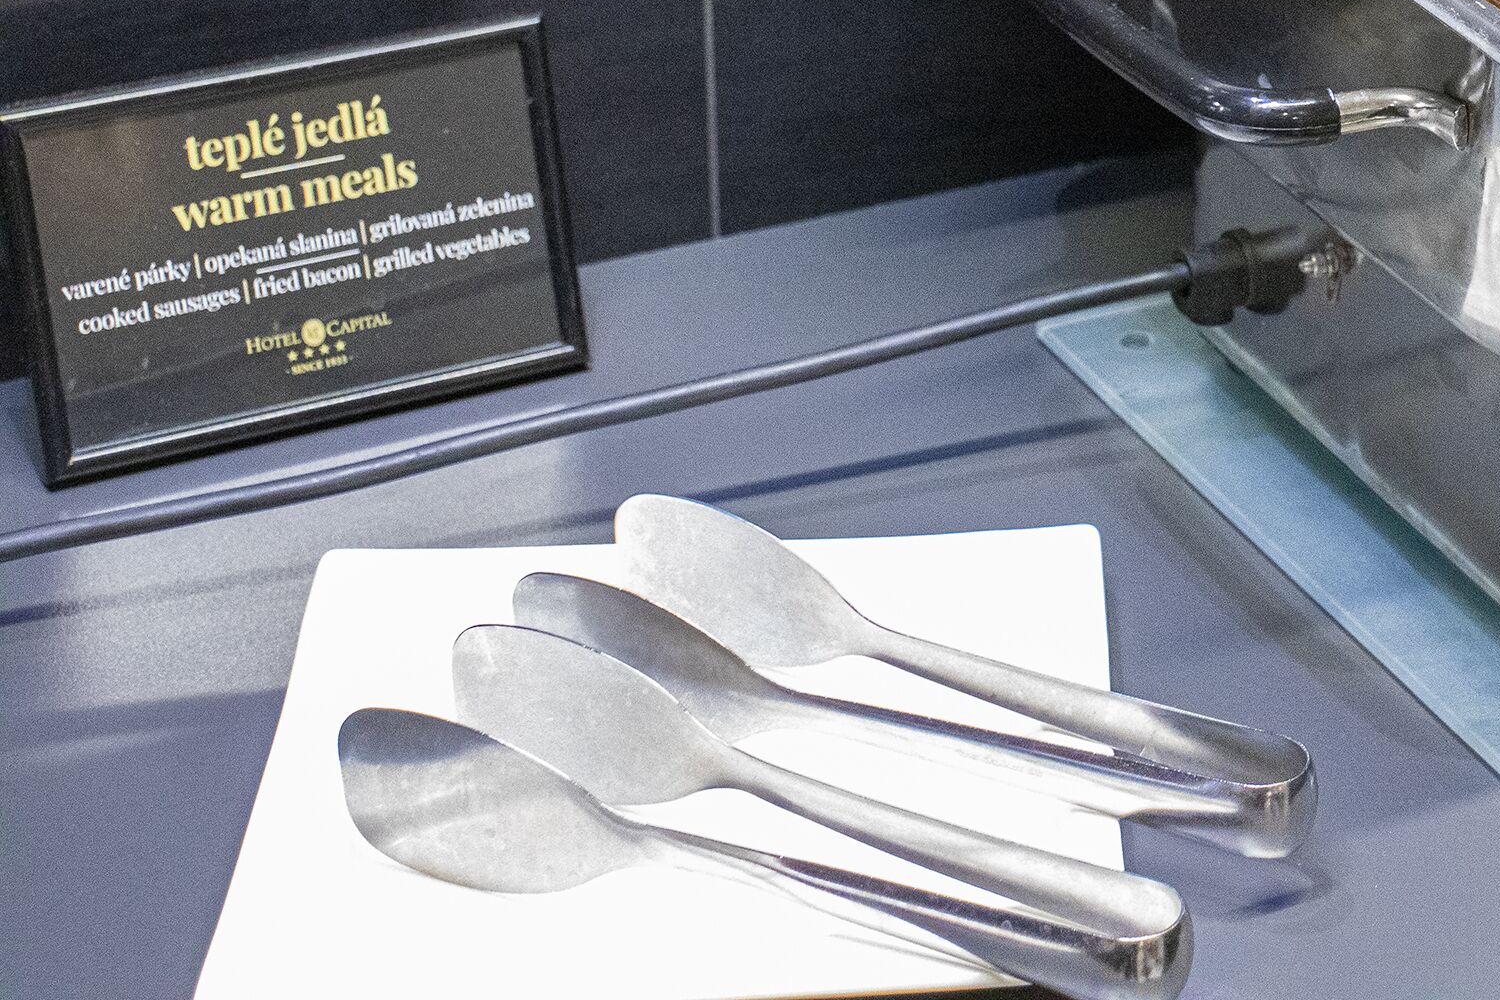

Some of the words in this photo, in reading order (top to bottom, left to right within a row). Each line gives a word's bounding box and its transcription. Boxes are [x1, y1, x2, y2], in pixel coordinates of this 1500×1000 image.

[184, 113, 285, 172] teplé
[291, 94, 391, 159] jedlá
[171, 183, 295, 232] warm
[301, 153, 419, 208] meals
[61, 267, 132, 301] varené
[134, 259, 191, 291] párky
[204, 236, 287, 275] opekaná
[289, 227, 359, 256] slanina
[369, 202, 456, 243] grilovaná
[457, 191, 536, 222] zelenina
[78, 301, 150, 335] cooked
[153, 286, 241, 320] sausages
[253, 269, 301, 299] fried
[301, 262, 362, 289] bacon
[373, 241, 435, 278] grilled
[435, 225, 531, 261] vegetables
